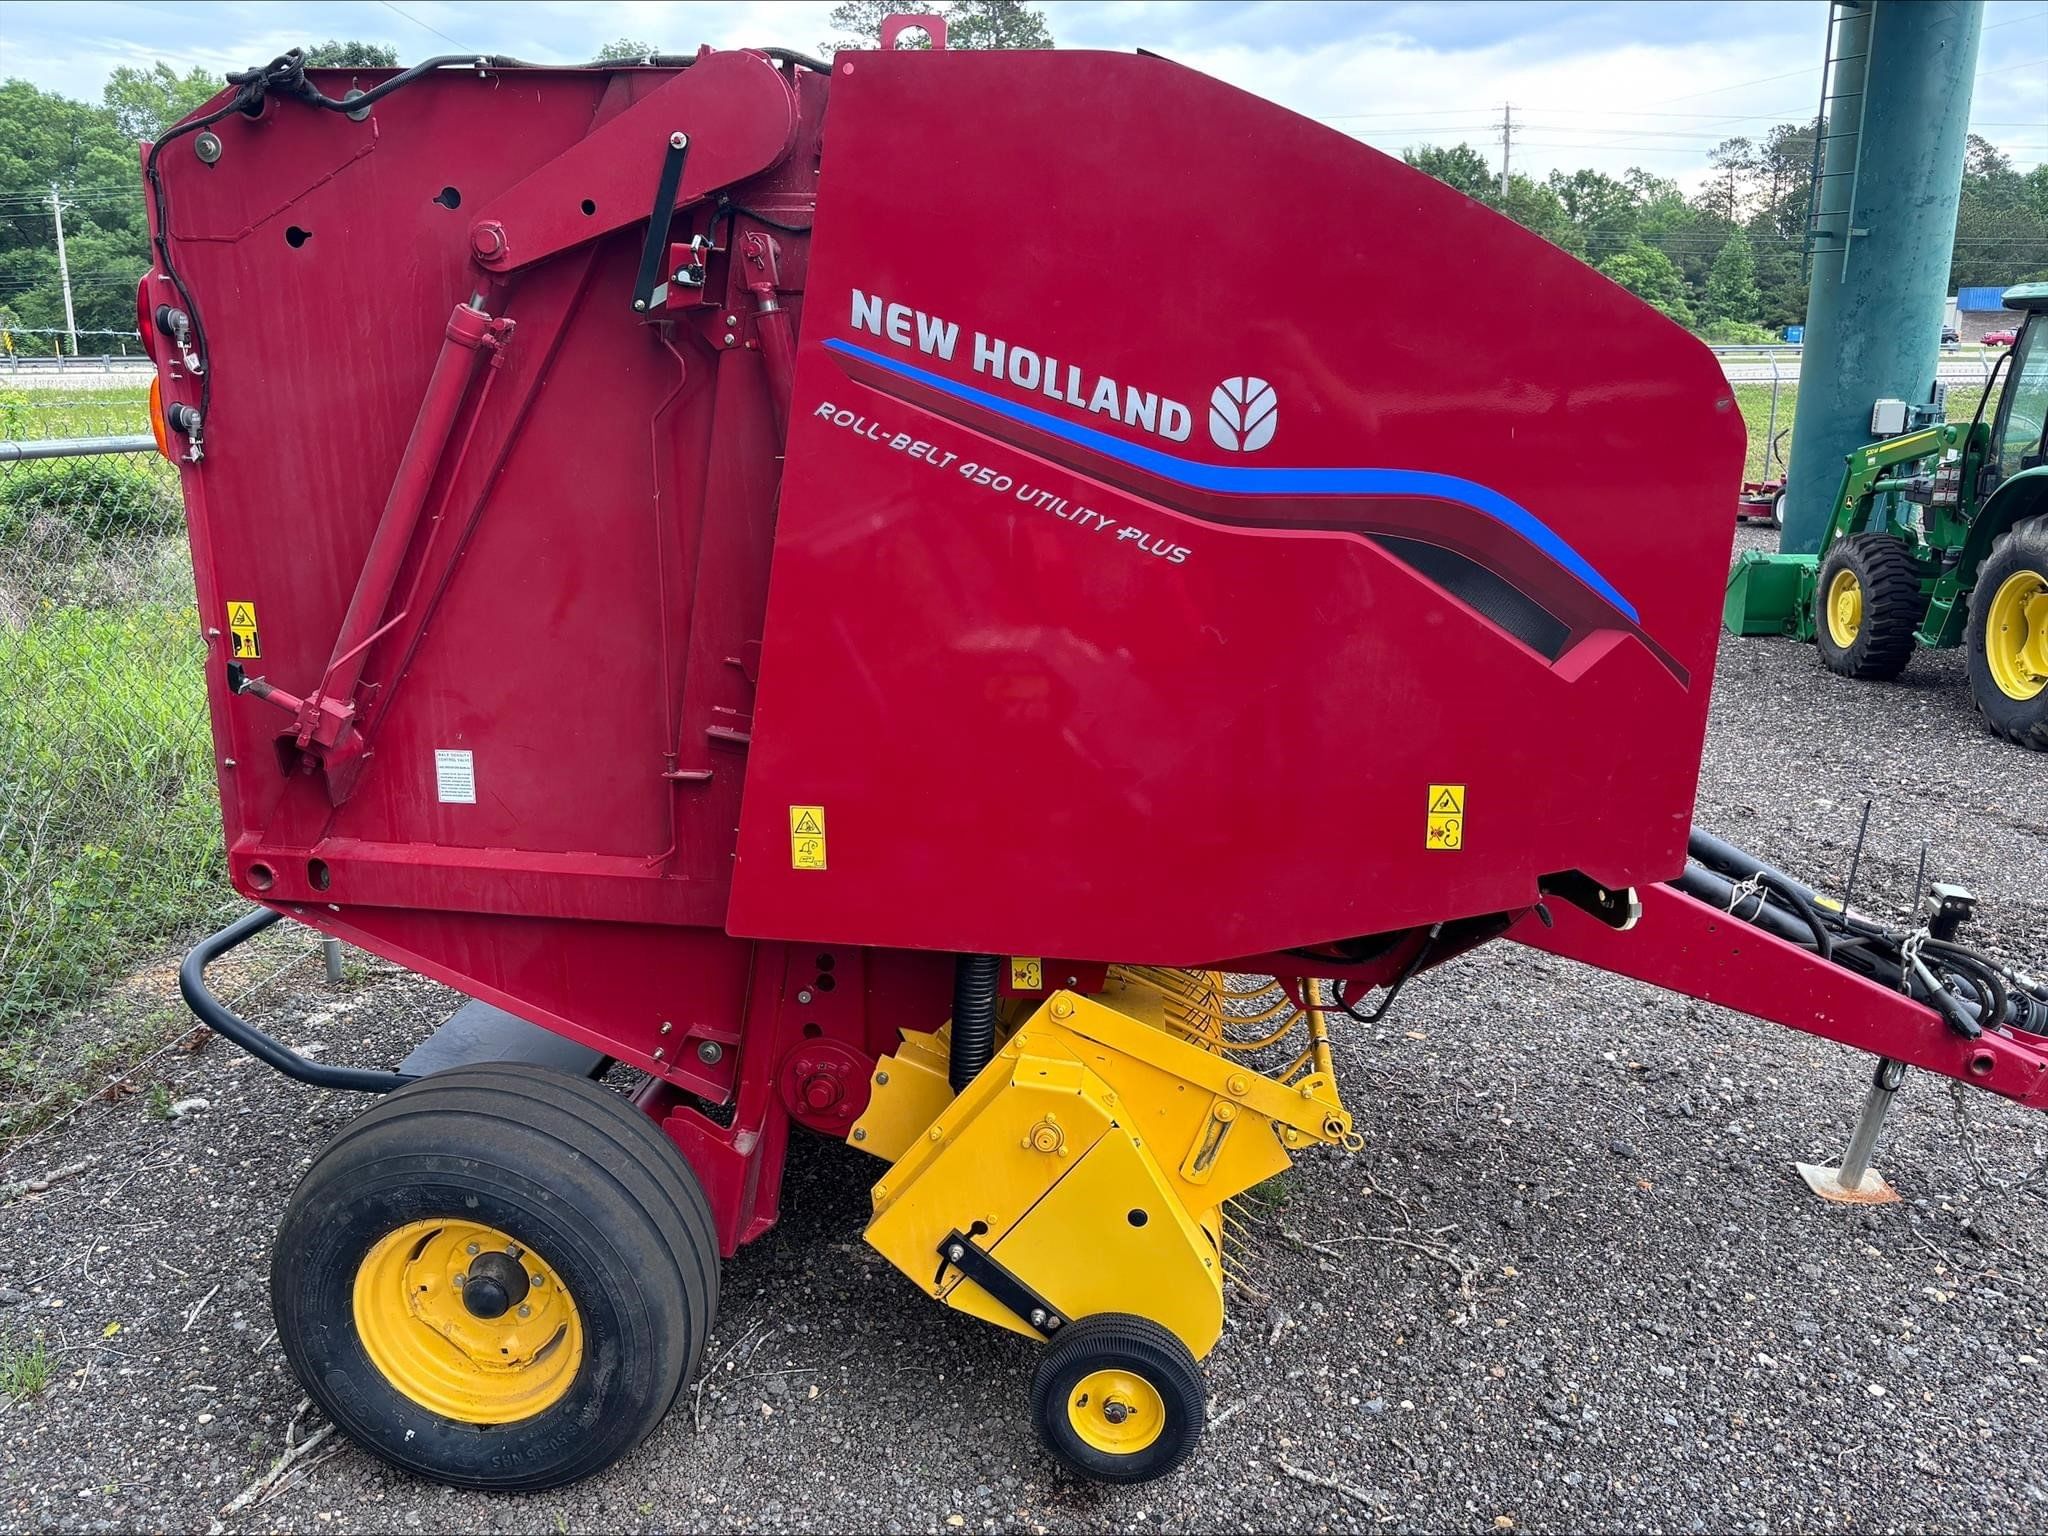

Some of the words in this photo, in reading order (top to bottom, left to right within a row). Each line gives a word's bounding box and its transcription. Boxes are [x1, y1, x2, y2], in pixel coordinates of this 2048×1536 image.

[851, 288, 959, 361] NEW
[973, 331, 1192, 443] HOLLAND
[813, 401, 958, 469] ROLL-BELT
[959, 461, 1013, 494] 450
[1015, 483, 1116, 533] UTILITY
